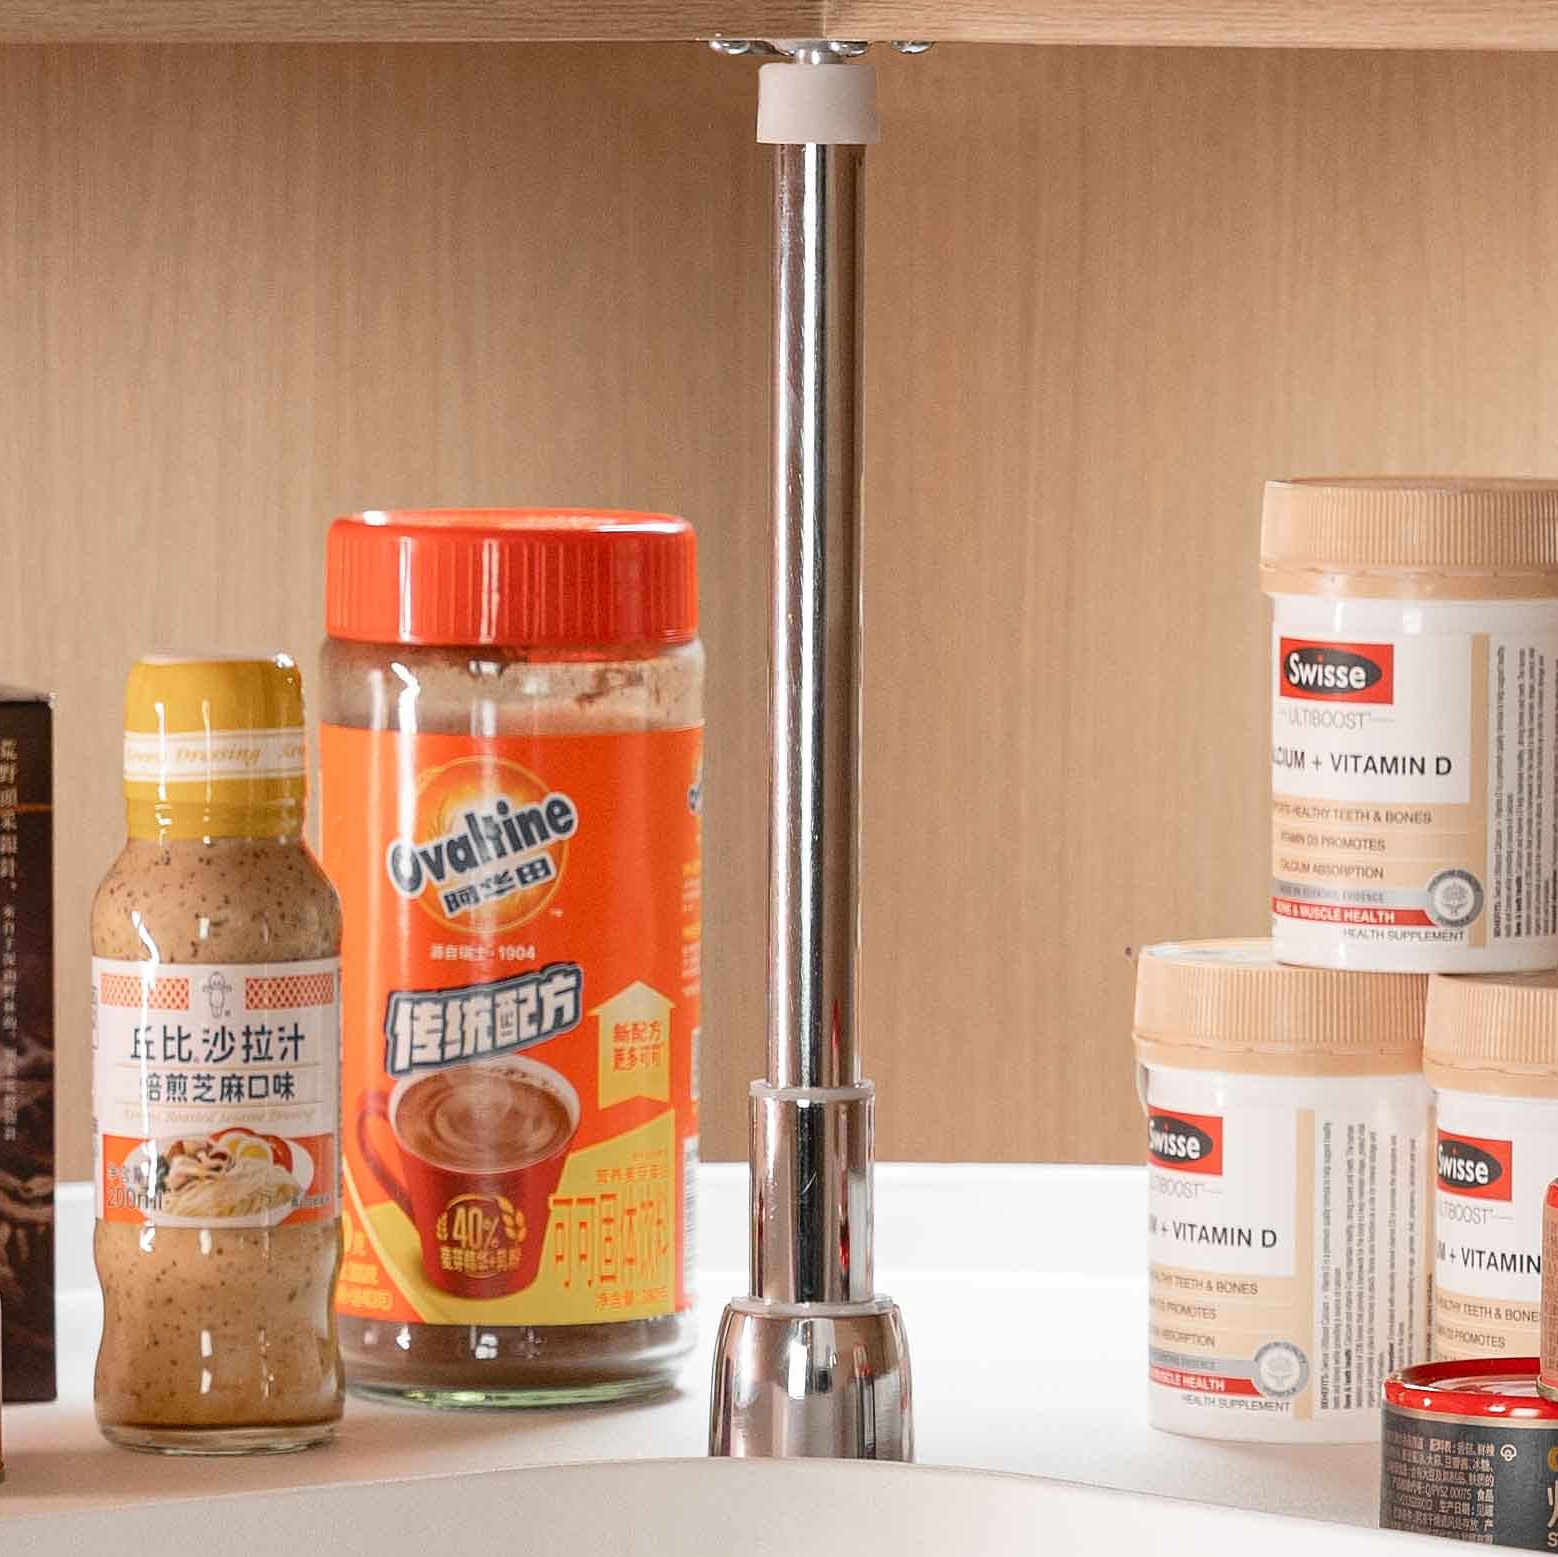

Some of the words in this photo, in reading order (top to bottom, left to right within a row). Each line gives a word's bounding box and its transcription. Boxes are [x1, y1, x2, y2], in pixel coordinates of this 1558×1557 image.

[1289, 652, 1367, 689] Swisse
[1330, 752, 1426, 776] VITAMIN
[1435, 756, 1453, 777] D
[1333, 808, 1370, 823] TEETH
[1385, 811, 1432, 825] BONES
[390, 796, 576, 894] Ovaltine
[1321, 836, 1386, 851] PROMOTES
[1312, 862, 1384, 879] ABSORPTION
[443, 857, 552, 915] 阿华田
[1343, 908, 1395, 924] HEALTH
[1343, 927, 1385, 941] HEALTH
[1387, 929, 1465, 943] SUPPLEMENT
[393, 973, 579, 1071] 传统配方
[612, 1021, 663, 1043] 新配方
[107, 1187, 163, 1211] 200ml
[453, 1206, 501, 1250] 40%
[1171, 1219, 1252, 1248] VITAMIN
[1261, 1228, 1278, 1249] D
[1461, 1247, 1542, 1275] VITAMIN
[1215, 1280, 1259, 1296] BONES
[1505, 1307, 1540, 1323] BONE
[1454, 1329, 1506, 1350] PROMOTES
[1182, 1372, 1226, 1392] HEALTH
[1217, 1397, 1292, 1413] SUPPLEMENT
